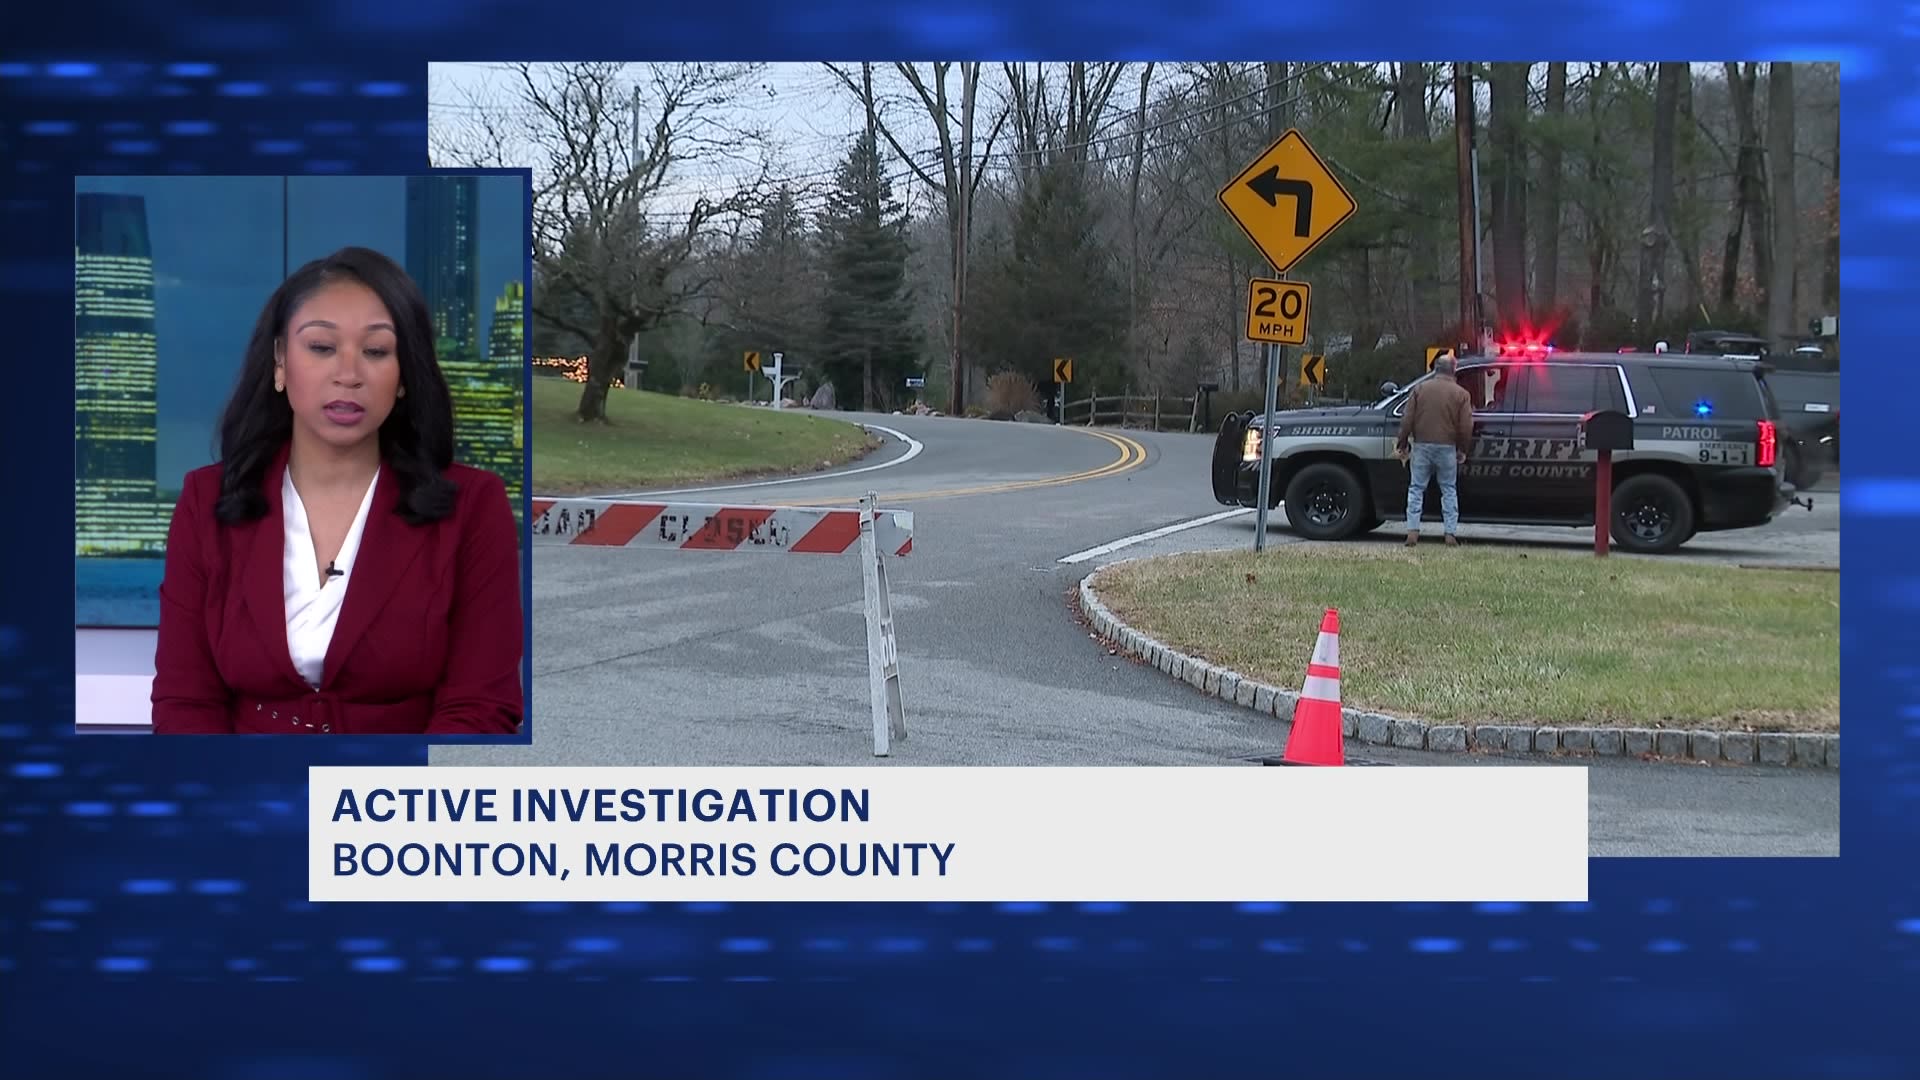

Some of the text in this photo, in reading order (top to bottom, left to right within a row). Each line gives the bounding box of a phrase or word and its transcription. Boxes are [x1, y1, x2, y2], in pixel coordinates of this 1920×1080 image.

[1255, 287, 1302, 320] 20
[1259, 321, 1294, 337] MPH
[1291, 426, 1357, 435] SHERIFF
[1662, 426, 1721, 440] PATROL
[1472, 438, 1586, 460] ERIFF
[1699, 449, 1748, 465] 9-1-1
[1459, 464, 1591, 478] RRIS COUNTY
